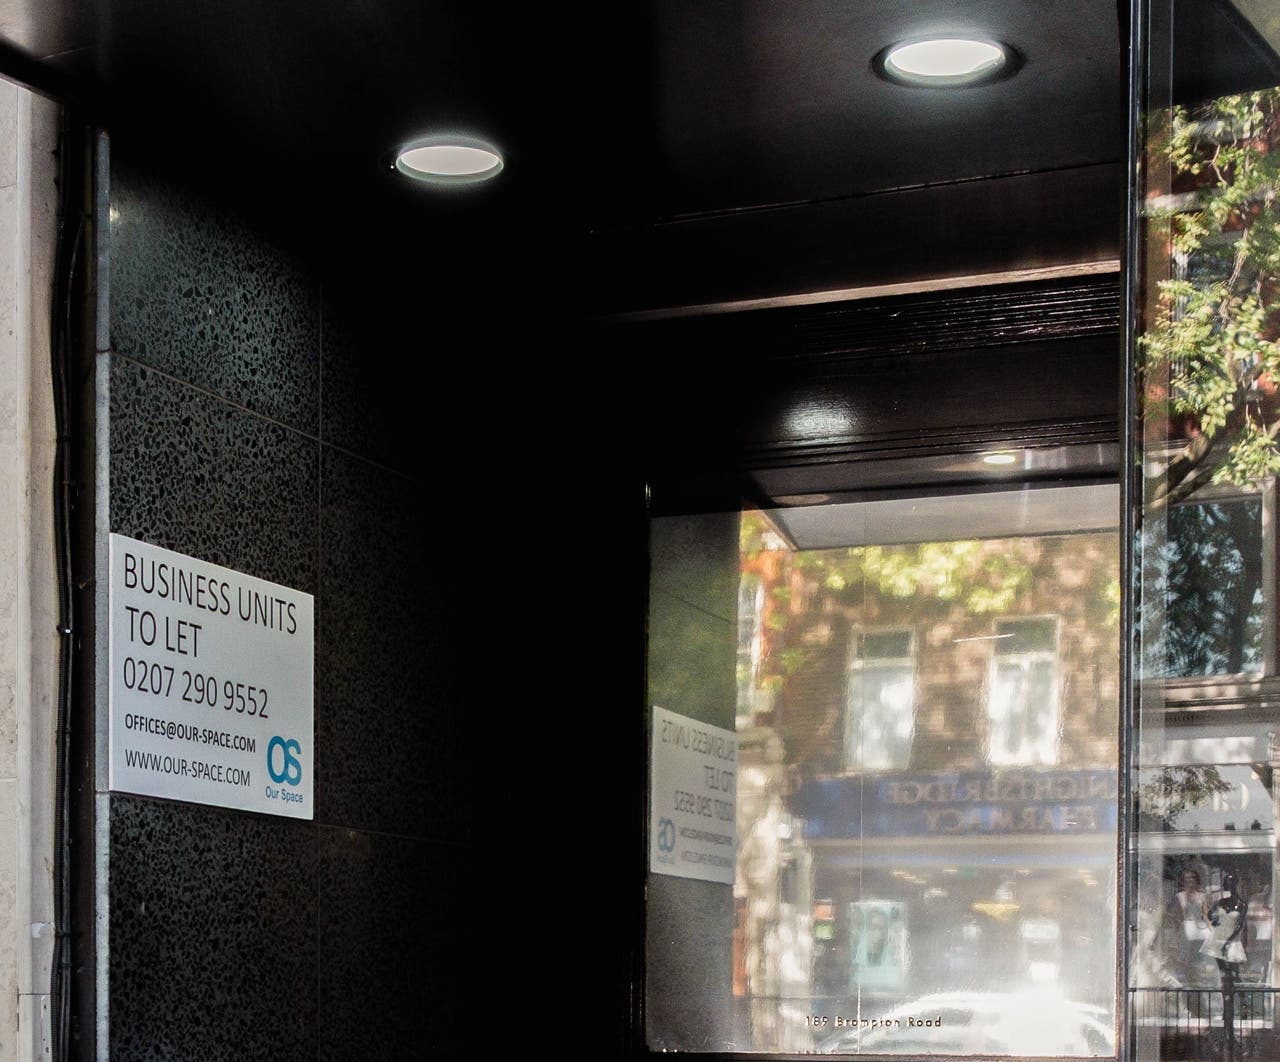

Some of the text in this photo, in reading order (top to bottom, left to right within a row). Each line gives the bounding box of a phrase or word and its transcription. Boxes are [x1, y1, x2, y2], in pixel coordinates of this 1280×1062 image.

[124, 553, 297, 634] BUSINESS UNITS
[125, 606, 202, 657] TO LET
[124, 657, 269, 719] 0207 290 9552
[125, 713, 256, 753] OFFICES@OUR-SPACE.COM
[125, 749, 251, 787] WWW.OUR-SPACE.COM
[265, 786, 303, 804] Our Space
[805, 1016, 942, 1029] 189 Brompton Road
